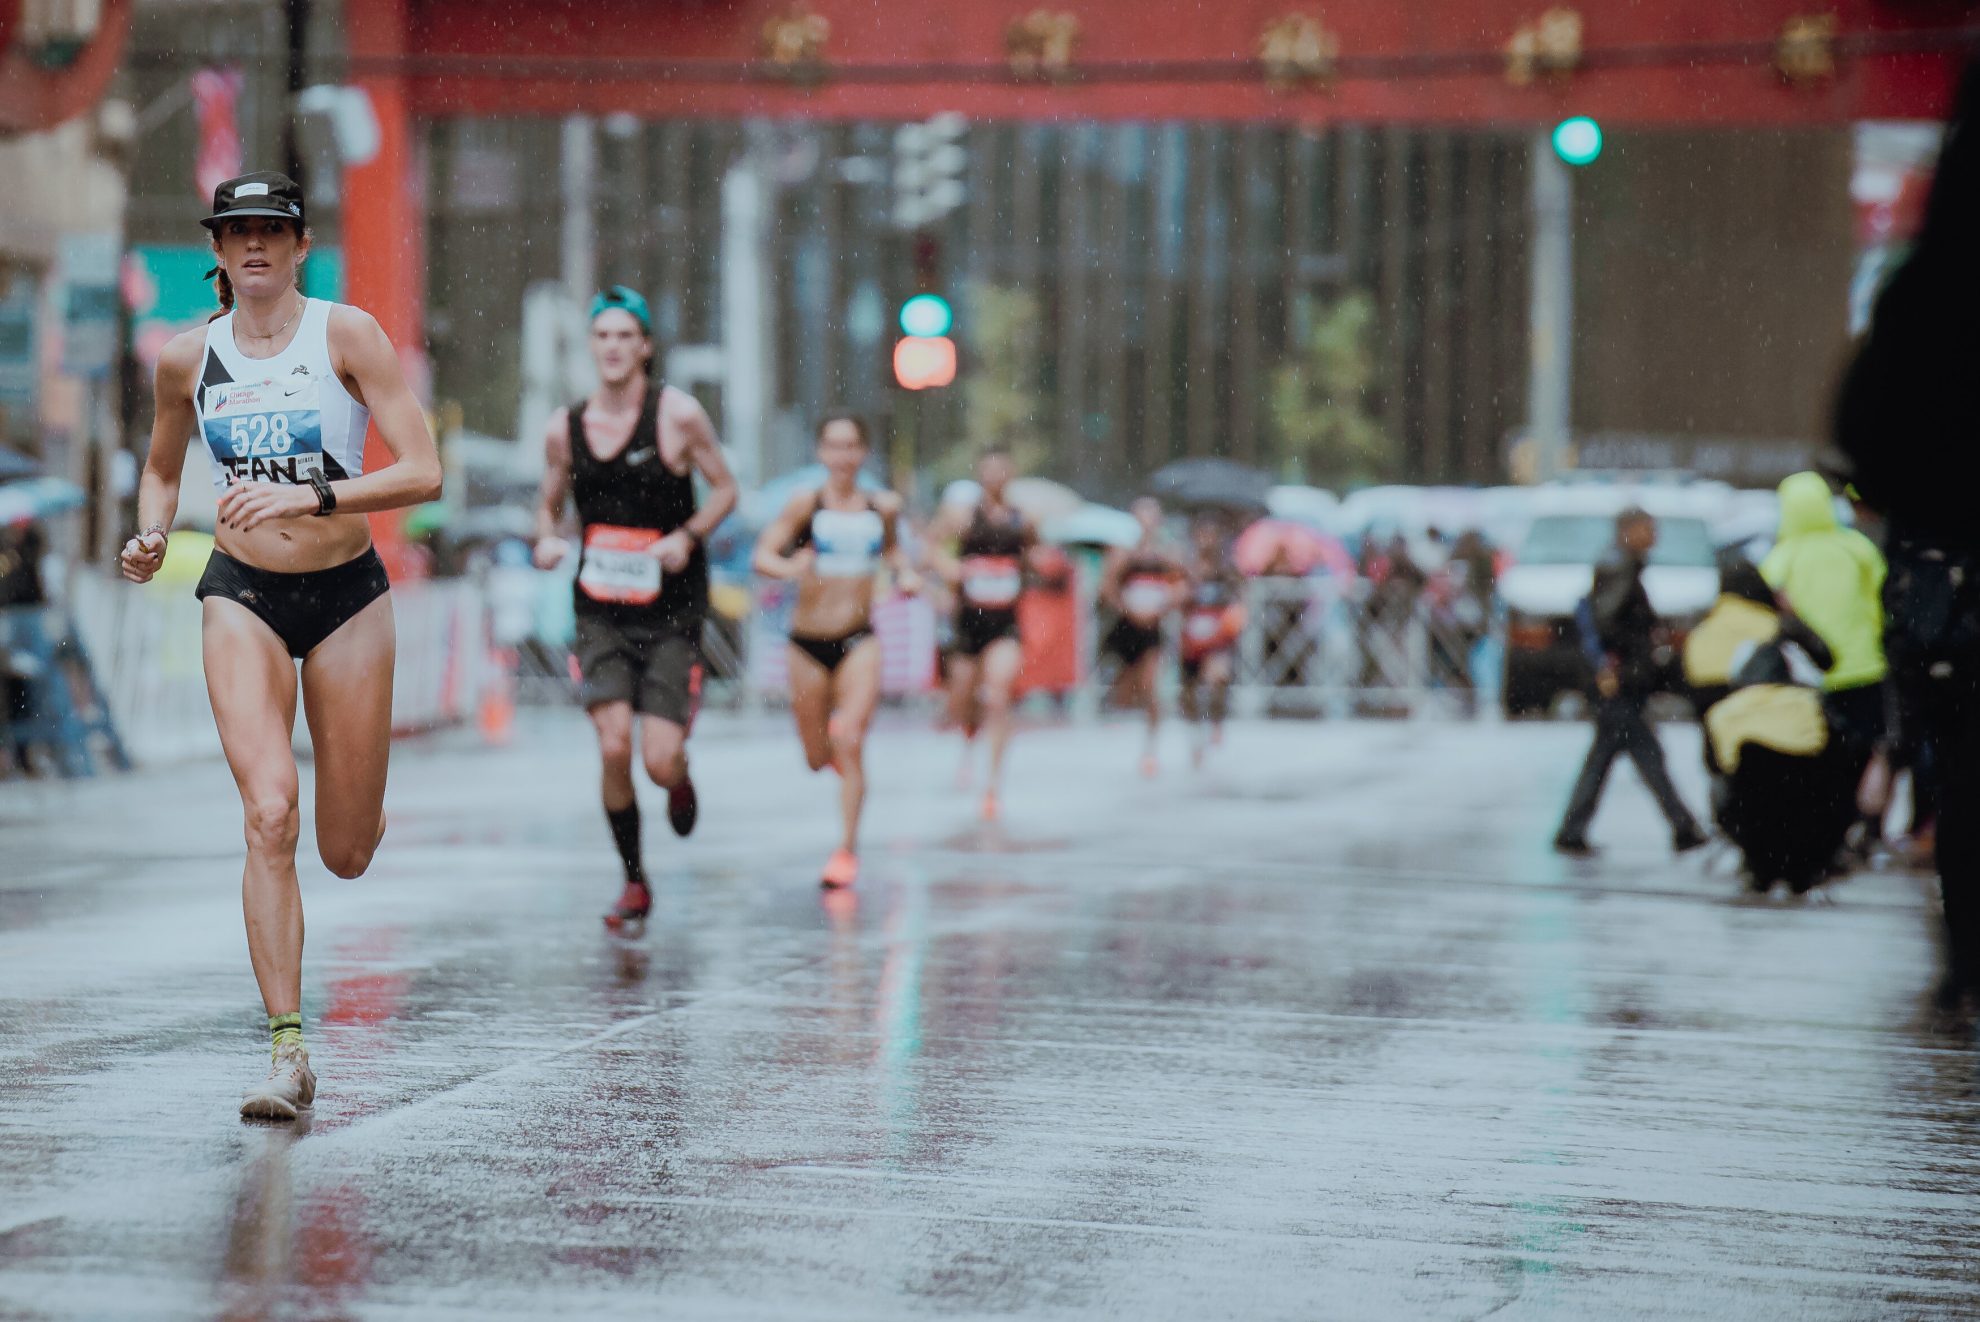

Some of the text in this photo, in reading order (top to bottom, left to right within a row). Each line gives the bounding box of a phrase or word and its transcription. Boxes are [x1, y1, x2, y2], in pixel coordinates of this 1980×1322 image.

[229, 391, 254, 399] Chicago
[229, 397, 261, 405] Marathon
[231, 413, 291, 457] 528
